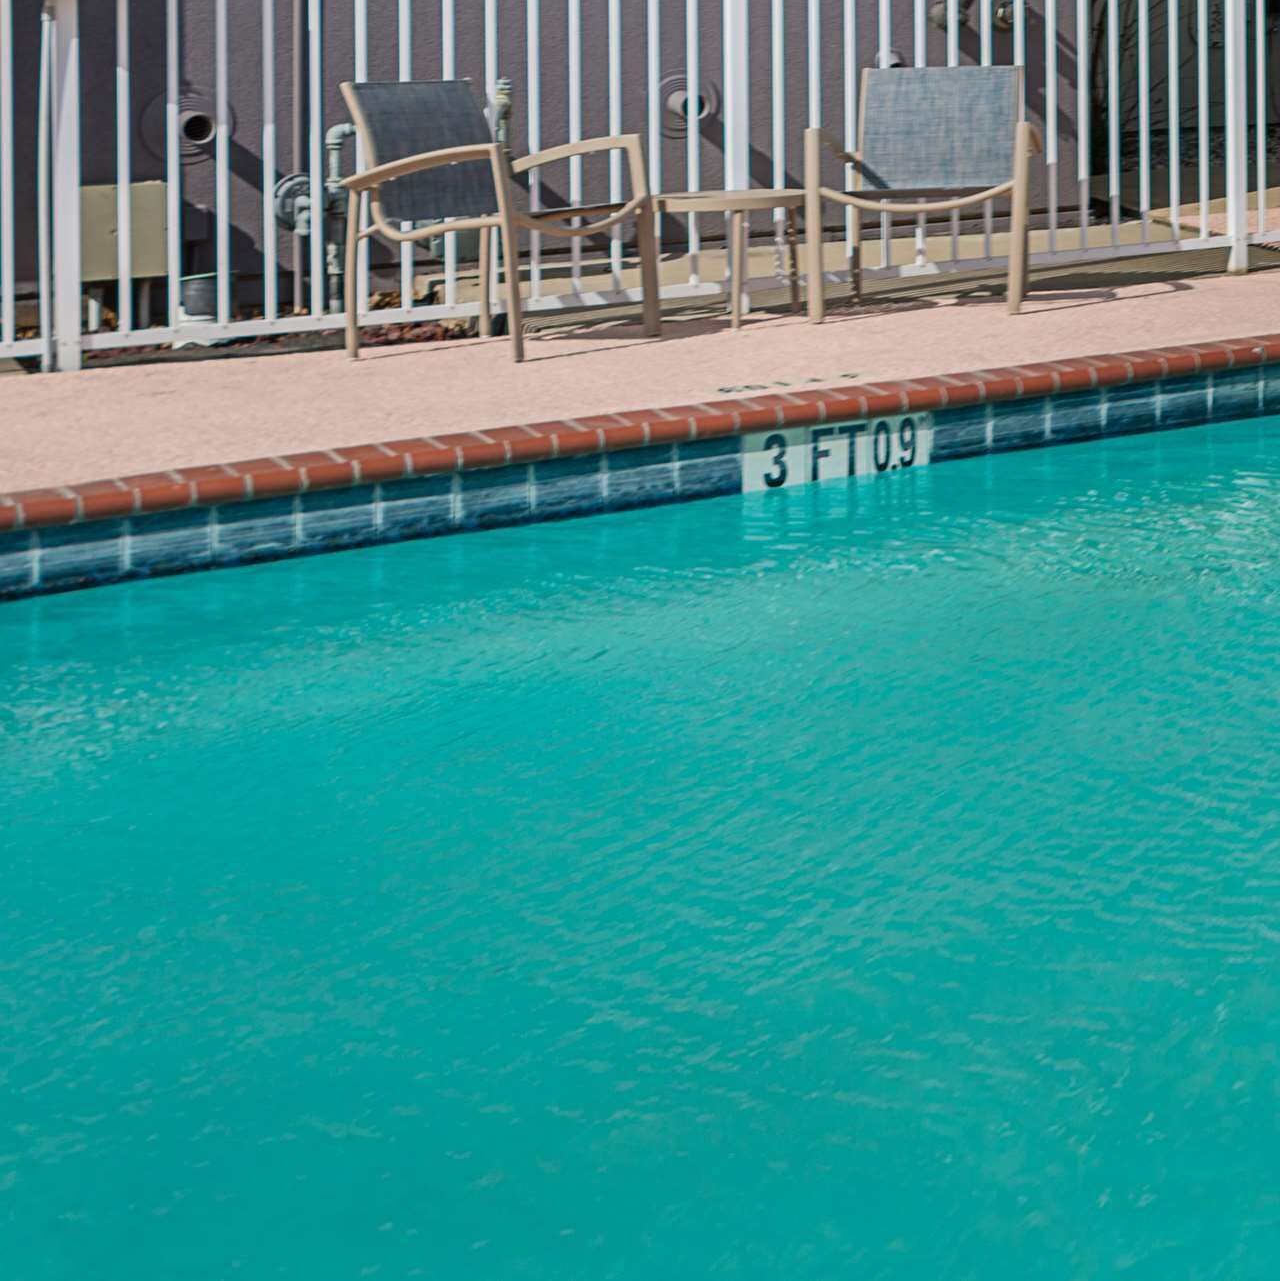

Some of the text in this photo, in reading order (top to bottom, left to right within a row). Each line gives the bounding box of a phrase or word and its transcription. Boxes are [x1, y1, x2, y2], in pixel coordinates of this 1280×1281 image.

[763, 416, 916, 488] 3 FT 0.9
